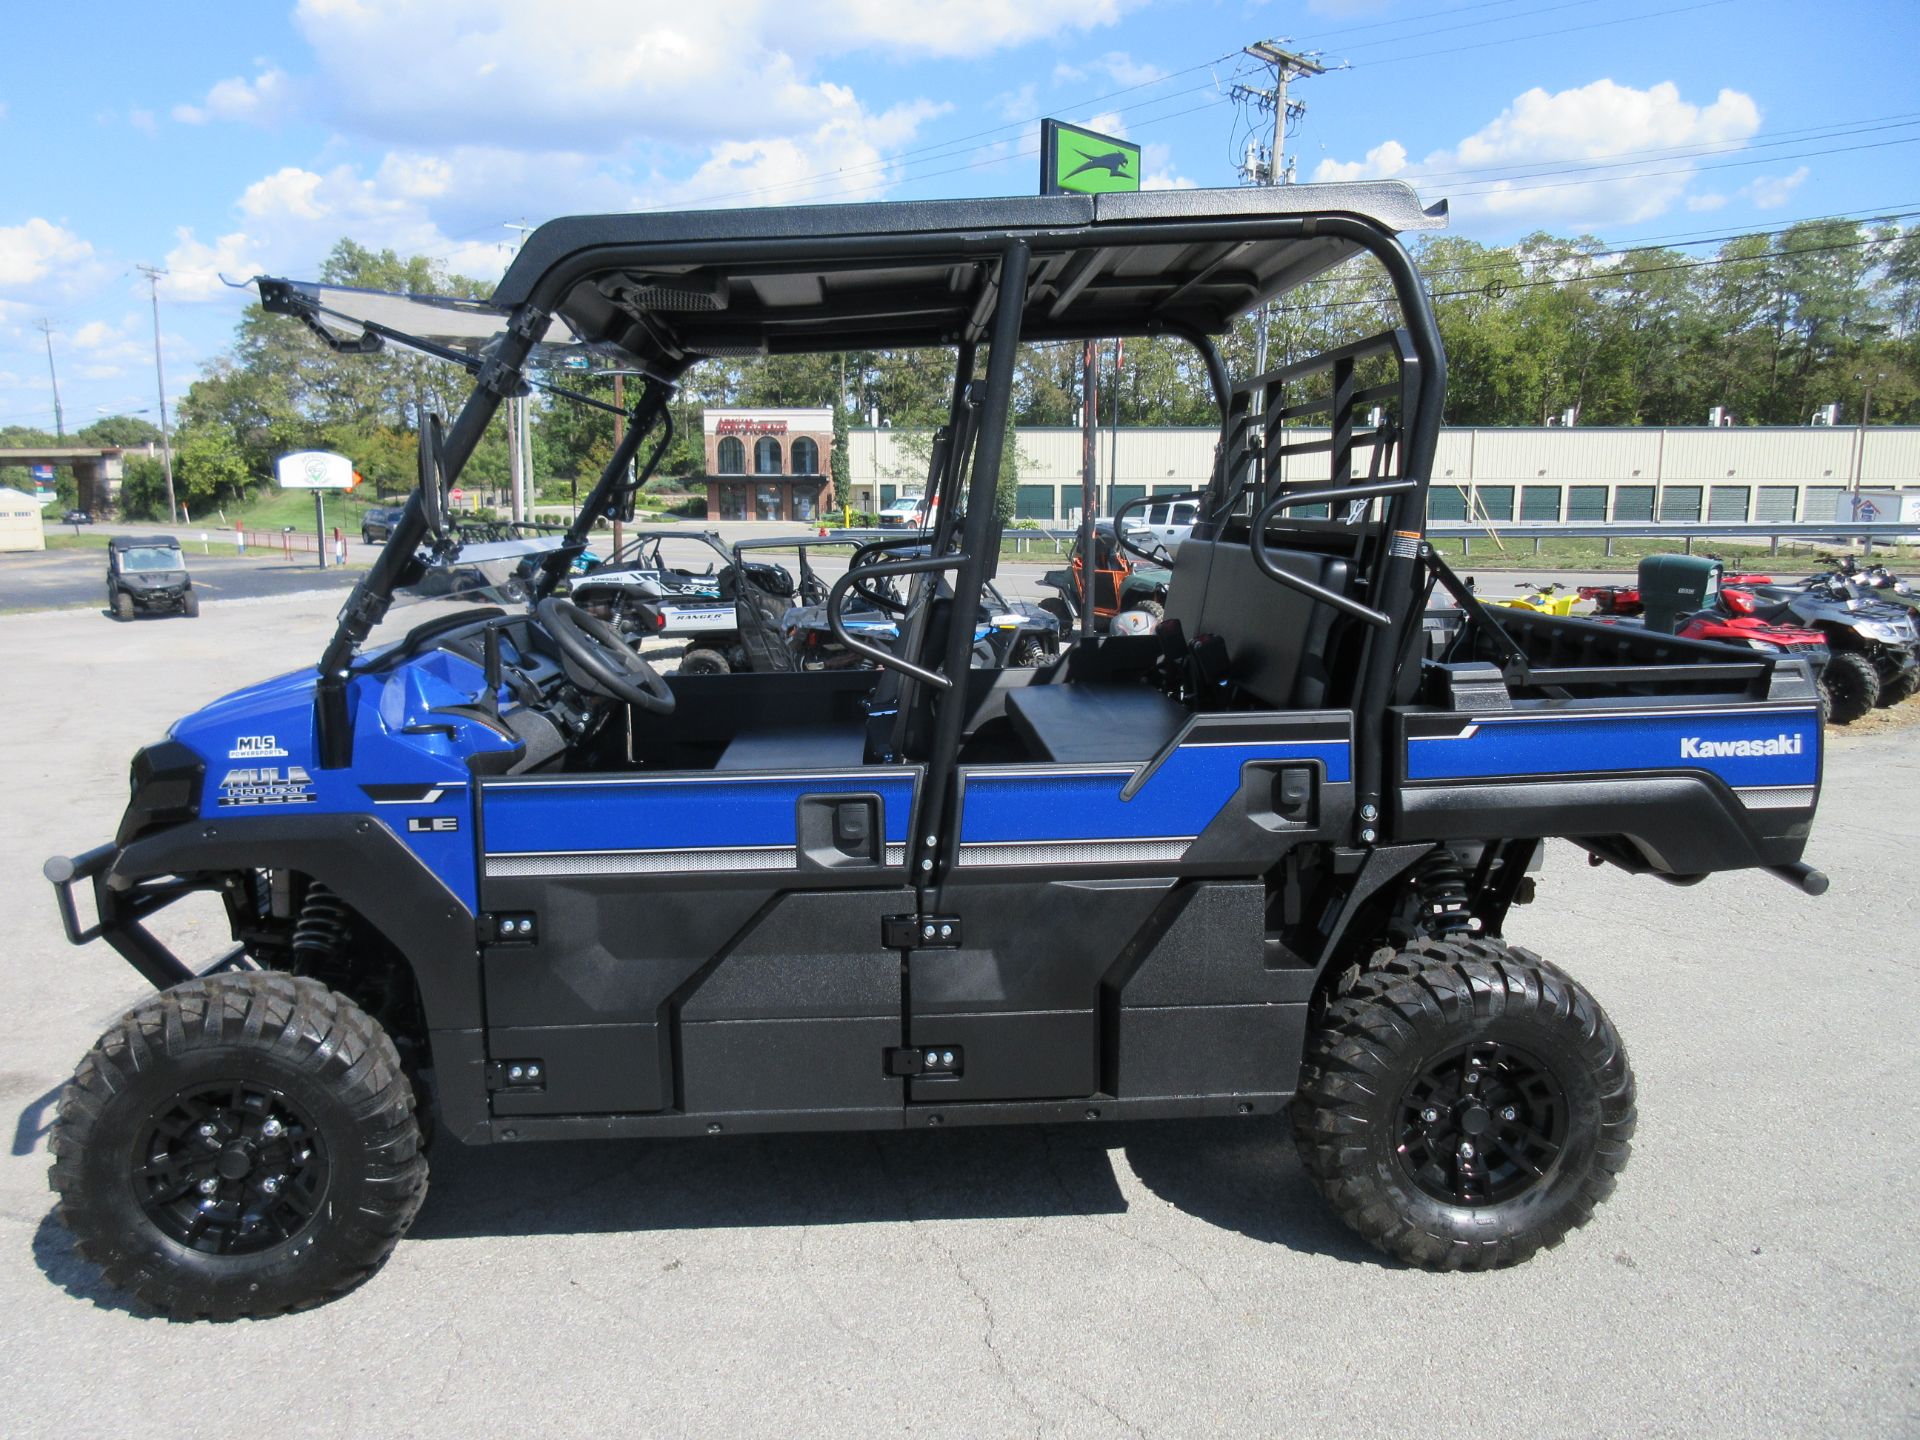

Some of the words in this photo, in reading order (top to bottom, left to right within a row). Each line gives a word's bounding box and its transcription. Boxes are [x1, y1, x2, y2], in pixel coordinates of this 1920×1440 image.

[238, 737, 275, 750] MLS
[1680, 733, 1801, 758] Kawasaki
[230, 749, 283, 757] POWERSPORTS
[408, 818, 457, 831] LE
